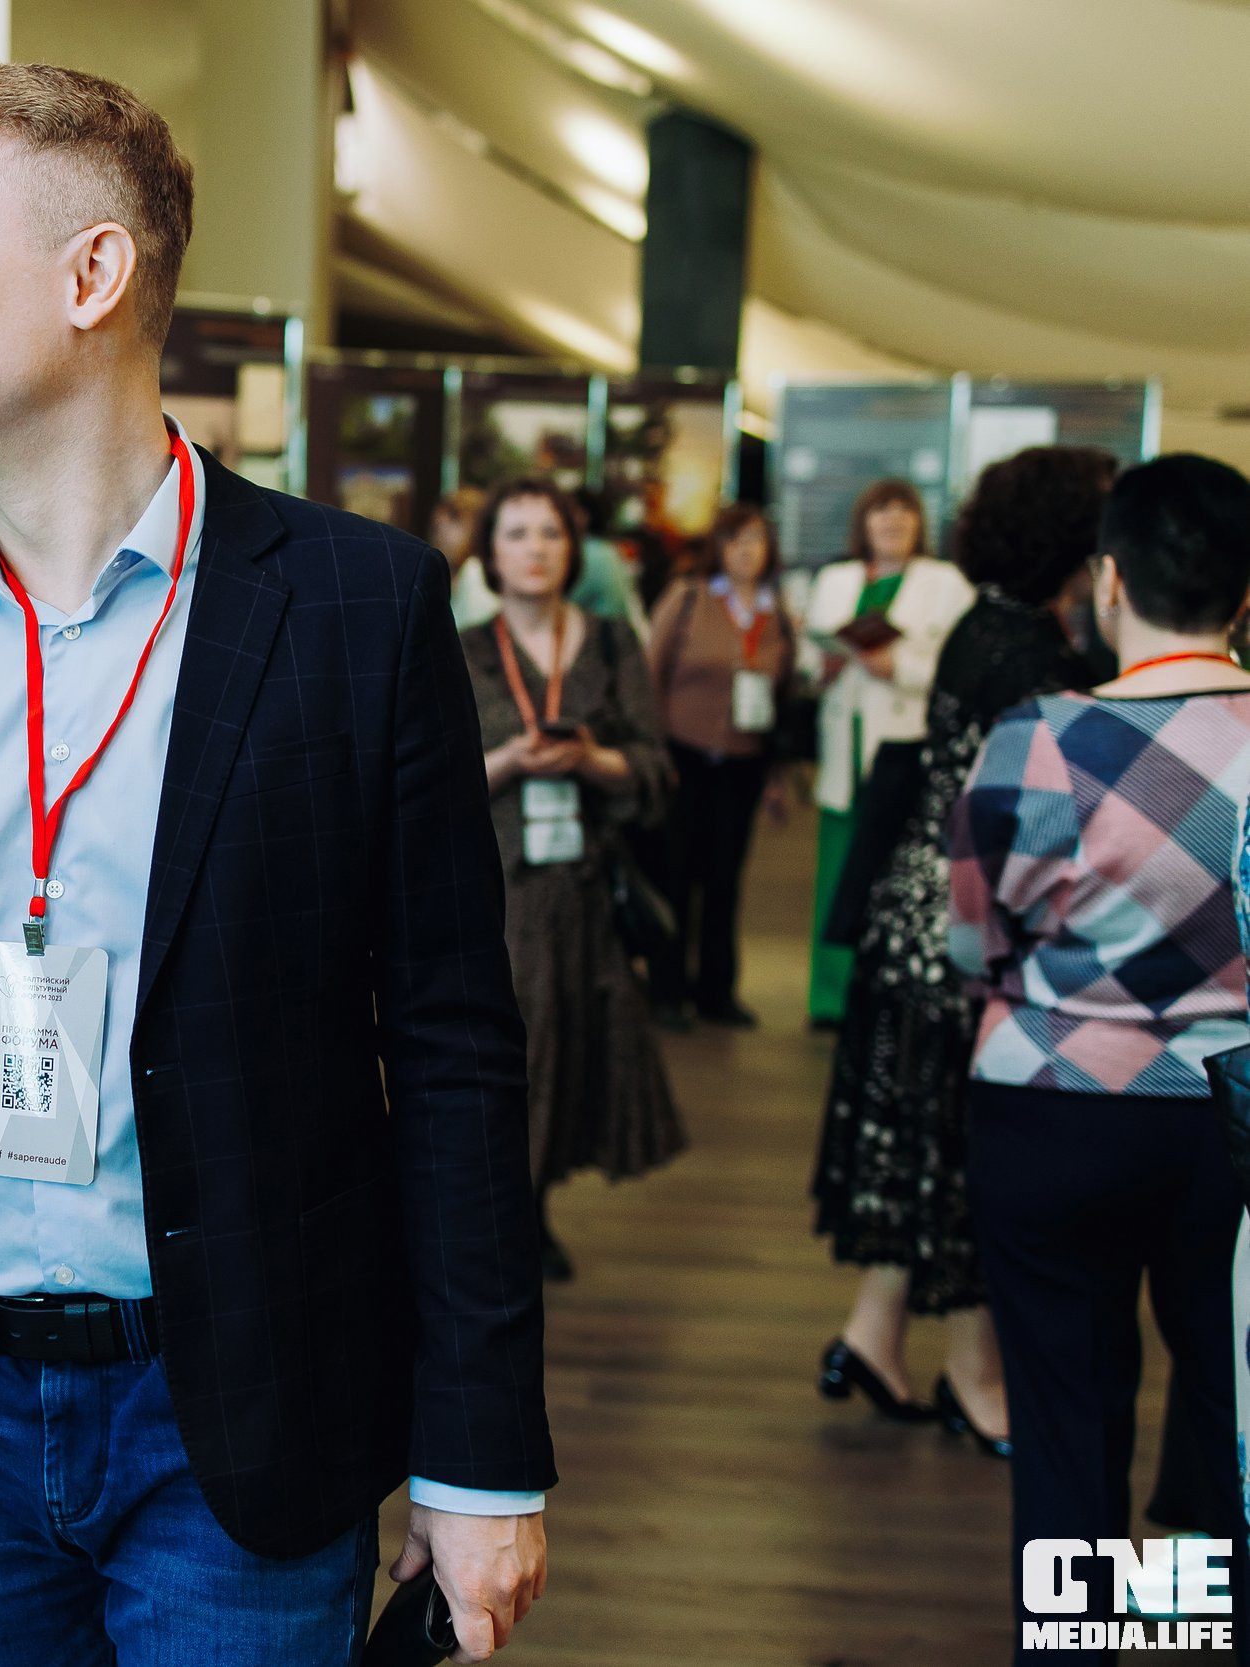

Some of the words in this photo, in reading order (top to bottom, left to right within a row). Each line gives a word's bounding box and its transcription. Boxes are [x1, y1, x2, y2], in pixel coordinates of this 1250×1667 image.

[22, 985, 68, 994] УЛЬТУРНЫЙ
[48, 994, 63, 1002] 2023
[1, 1025, 59, 1037] ПРОАММА
[1, 1035, 59, 1049] ФОРУМА
[7, 1151, 67, 1165] #sapereaude
